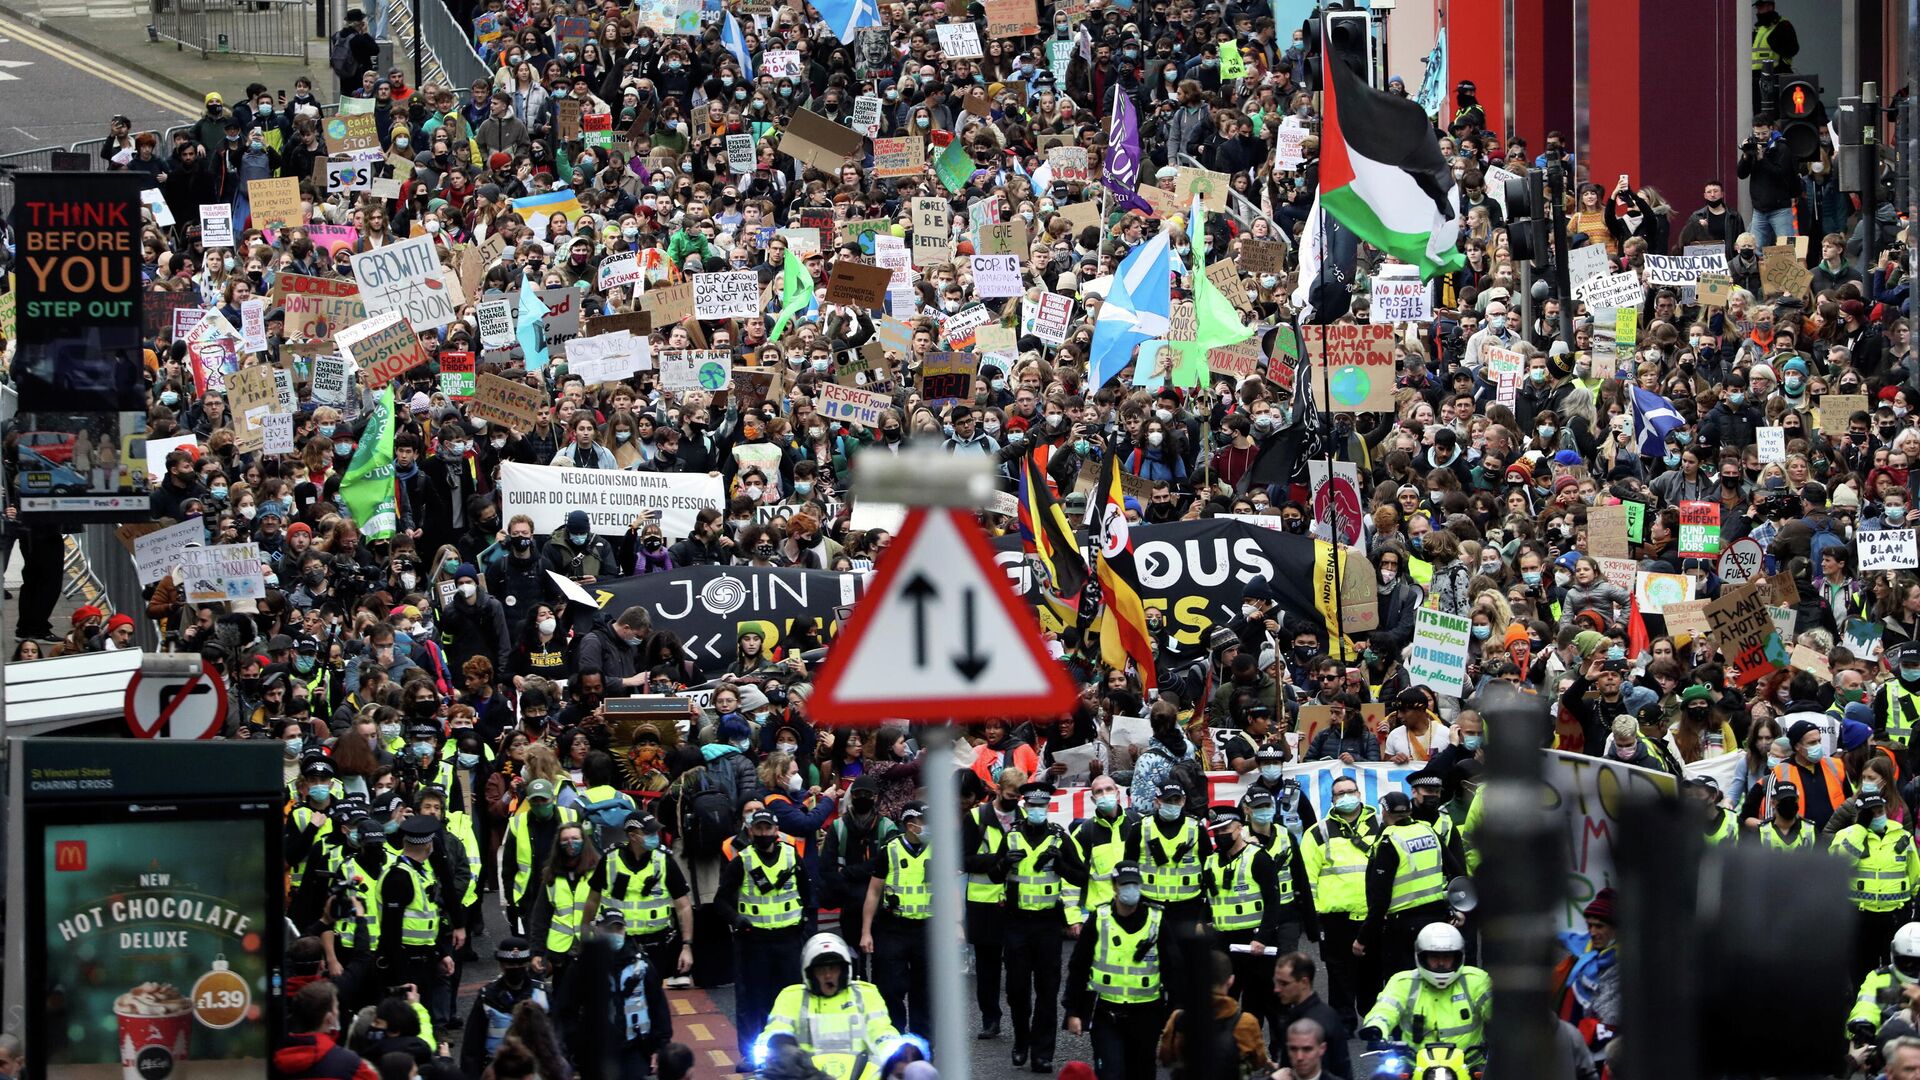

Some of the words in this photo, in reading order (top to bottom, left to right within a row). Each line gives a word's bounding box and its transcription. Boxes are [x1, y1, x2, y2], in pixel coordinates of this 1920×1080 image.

[1052, 42, 1076, 51] STOP
[764, 56, 785, 65] ACT
[764, 65, 786, 74] NOW
[344, 136, 373, 150] STOP
[585, 136, 612, 144] CLIMATE
[1051, 166, 1088, 180] NOW
[920, 200, 946, 212] BORIS
[26, 202, 129, 226] THINK
[925, 213, 944, 227] BE
[992, 225, 1013, 239] GIVE
[27, 231, 131, 251] BEFORE
[914, 234, 948, 248] BETTER
[1000, 238, 1008, 250] A
[358, 243, 433, 288] GROWTH
[1005, 257, 1016, 271] IS
[1645, 254, 1668, 270] NO
[1667, 255, 1702, 271] MUSIC
[1701, 255, 1724, 270] ON
[1776, 258, 1806, 278] STOP
[26, 255, 132, 294] YOU
[695, 274, 730, 285] EVERY
[730, 273, 757, 282] SECOND
[1611, 273, 1633, 289] STOP
[1651, 270, 1662, 283] A
[1661, 270, 1695, 283] DEAD
[600, 276, 616, 290] LAST
[696, 284, 719, 296] OUR
[721, 282, 758, 293] LEADERS
[1374, 284, 1390, 295] NO
[1393, 283, 1426, 296] MORE
[832, 290, 864, 302] CLOTHING
[835, 284, 876, 298] CONTINENTAL
[696, 294, 712, 305] DO
[716, 293, 738, 303] NOT
[742, 292, 758, 302] ACT
[1379, 296, 1424, 309] FOSSIL
[27, 301, 72, 318] STEP
[88, 301, 132, 318] OUT
[478, 306, 505, 316] SYSTEM
[479, 311, 507, 321] CHANGE
[698, 305, 720, 316] THEY
[721, 304, 744, 314] FAIL
[747, 303, 757, 313] US
[961, 303, 985, 318] WRONG
[1173, 305, 1193, 318] YOU
[1385, 306, 1423, 320] FUELS
[480, 319, 493, 327] NOT
[481, 322, 509, 332] CLIMATE
[351, 321, 409, 357] CLIMATE
[482, 328, 508, 337] CHANGE
[1035, 325, 1064, 339] TOGETHER
[1302, 326, 1312, 341] I
[1314, 325, 1359, 341] STAND
[1361, 324, 1394, 340] FOR
[358, 332, 416, 368] JUSTICE
[1326, 339, 1376, 352] WHAT
[441, 356, 467, 364] SCRAP
[836, 346, 863, 366] ONE
[926, 353, 951, 363] TIME
[960, 352, 973, 364] IS
[1212, 350, 1233, 371] YOUR
[1233, 356, 1257, 374] ARSE
[1283, 353, 1299, 369] NOT
[1318, 351, 1365, 367] STAND
[1364, 351, 1393, 366] ON
[317, 361, 343, 370] SYSTEM
[317, 367, 344, 376] CHANGE
[373, 349, 420, 383] NOW
[441, 363, 473, 371] TRIDENT
[315, 377, 343, 386] CLIMATE
[441, 373, 462, 381] FUND
[855, 367, 885, 385] ONE
[314, 383, 342, 392] CHANGE
[441, 380, 474, 389] CLIMATE
[925, 374, 964, 400] 2021
[442, 388, 462, 396] JOBS
[824, 384, 871, 405] RESPECT
[869, 398, 891, 411] YOUR
[263, 440, 292, 451] CLIMATE
[561, 472, 638, 488] NEGACIONISMO
[640, 475, 671, 489] MATA.
[509, 491, 546, 505] CUIDAR
[549, 491, 563, 505] DO
[565, 491, 599, 506] CLIMA
[600, 489, 607, 506] É
[609, 493, 646, 507] CUIDAR
[649, 494, 669, 509] DAS
[672, 496, 717, 510] PESSOAS
[1681, 506, 1712, 515] SCRAP
[1681, 514, 1719, 525] TRIDENT
[171, 525, 201, 538] HISTORY
[1681, 524, 1706, 535] FUND
[1680, 533, 1720, 545] CLIMATE
[1858, 533, 1875, 544] NO
[1680, 541, 1705, 552] JOBS
[1869, 543, 1903, 555] BLAH
[181, 550, 201, 565] STOP
[205, 549, 221, 563] THE
[219, 545, 257, 562] WARMING
[1725, 552, 1758, 565] FOSSIL
[1862, 554, 1886, 567] BLAH
[1891, 554, 1916, 566] BLAH
[183, 565, 202, 580] STOP
[206, 563, 222, 578] THE
[1603, 560, 1635, 571] SKIPPING
[1724, 567, 1752, 580] FUELS
[655, 571, 809, 620] JOIN
[1708, 608, 1726, 631] I
[1727, 590, 1764, 619] WANT
[1418, 611, 1438, 627] IT'S
[1438, 614, 1470, 634] MAKE
[1416, 627, 1466, 648] sacrifices
[1719, 630, 1731, 645] A
[1730, 619, 1755, 638] HOT
[1740, 630, 1763, 654] NOT
[530, 656, 564, 666] TIERRA
[1413, 645, 1429, 659] OR
[1429, 647, 1464, 669] BREAK
[1742, 648, 1770, 673] HOT
[1410, 665, 1428, 678] the
[1427, 669, 1464, 687] planet
[31, 769, 42, 779] St
[44, 768, 79, 779] Vincent
[81, 768, 110, 779] Street
[31, 779, 77, 791] CHARING
[79, 778, 114, 790] CROSS
[1407, 836, 1437, 852] POLICE
[140, 873, 171, 887] NEW
[58, 906, 104, 941] HOT
[111, 896, 250, 937] CHOCOLATE
[119, 930, 188, 949] DELUXE
[196, 989, 245, 1009] £1.39
